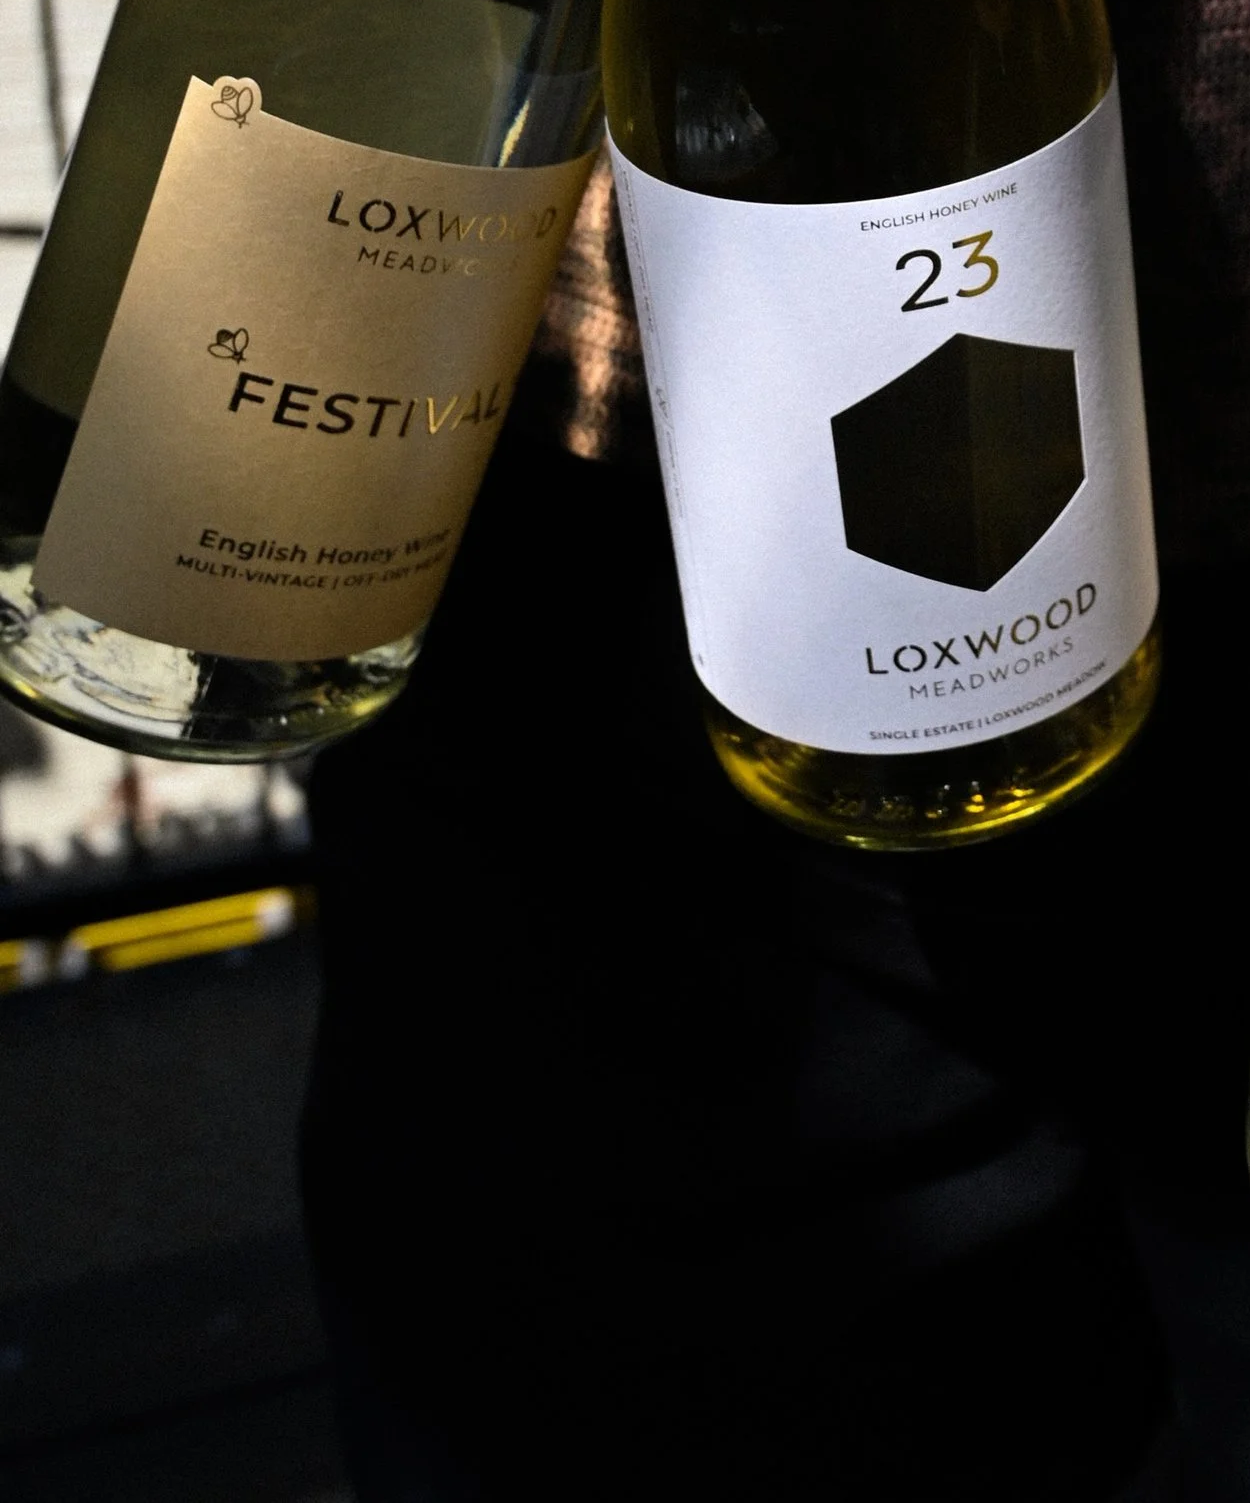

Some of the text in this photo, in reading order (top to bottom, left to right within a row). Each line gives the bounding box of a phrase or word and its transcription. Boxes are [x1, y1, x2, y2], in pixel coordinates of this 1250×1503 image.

[860, 182, 1019, 232] ENGLISH HONEY WINE
[895, 229, 1000, 313] 23
[228, 371, 502, 438] FESTIVAL
[176, 554, 326, 589] MULTI-VINTAGE
[199, 528, 308, 564] English
[316, 546, 396, 567] Honey
[866, 582, 1098, 675] LOXWOOD
[909, 636, 1074, 700] MEADWORKS
[869, 729, 920, 741] SINGLE
[924, 720, 976, 739] ESTATE
[985, 692, 1055, 726] LOXWOOD
